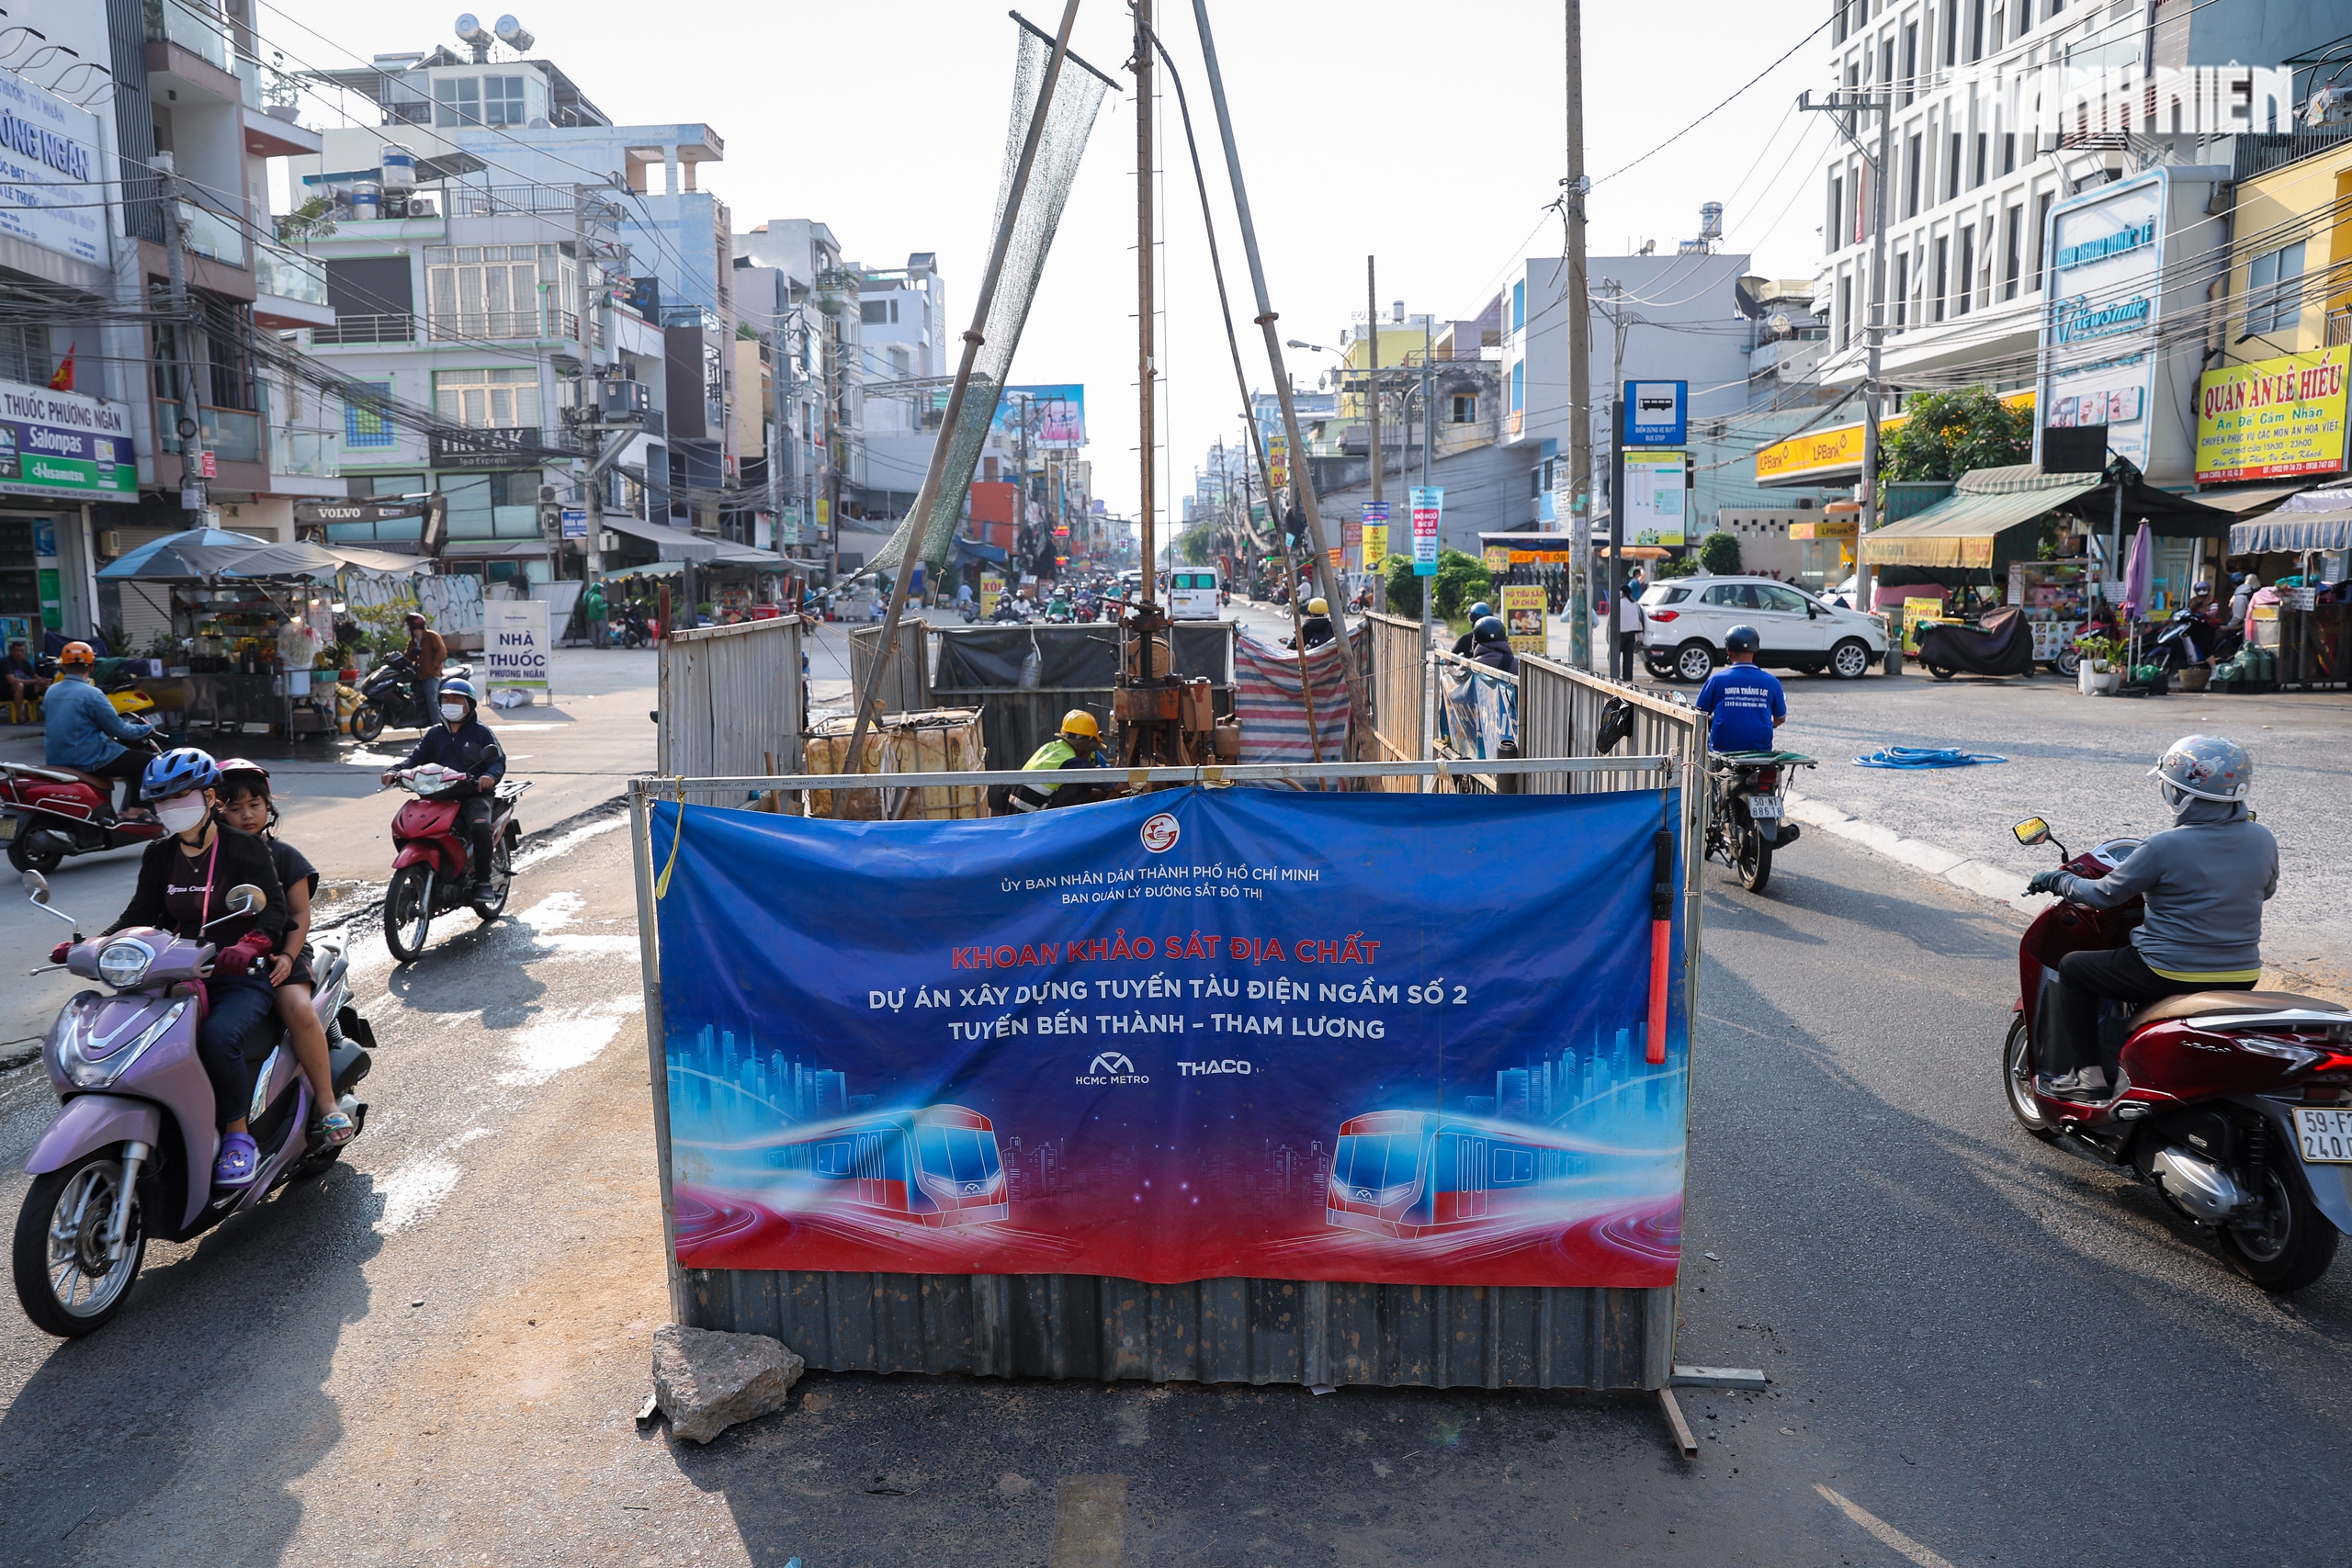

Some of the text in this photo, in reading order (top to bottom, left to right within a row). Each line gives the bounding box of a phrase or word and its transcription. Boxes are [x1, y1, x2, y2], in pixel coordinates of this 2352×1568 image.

[2204, 351, 2343, 421] QUÁN ĂN LÊ HIẾU
[5, 390, 122, 432] THUỐC PHƯƠNG NGÂN
[2260, 412, 2284, 424] Cảm
[2292, 407, 2323, 422] Nhận
[1665, 423, 1676, 434] BUÝT
[2201, 418, 2340, 447] CHUYÊN PHỤC VỤ CÁC MÓN ĂN HOA VIỆT
[29, 426, 83, 455] Salonpas
[2264, 441, 2284, 451] 15h30
[2290, 438, 2312, 448] 23h00
[1813, 443, 1840, 461] LPBank
[2299, 448, 2323, 459] Khách
[477, 457, 507, 466] Express
[1760, 453, 1782, 470] LPBank
[31, 462, 85, 482] Hisamitsu
[318, 508, 361, 519] VOLVO
[1821, 527, 1849, 536] LPBank
[982, 580, 1002, 593] XÔI
[1516, 589, 1530, 598] TIẾU
[1531, 589, 1545, 598] XÀO
[1511, 598, 1521, 606] ÁP
[500, 629, 535, 646] NHÀ
[489, 649, 546, 667] THUỐC
[490, 668, 546, 678] PHƯƠNG NGÂN
[1724, 687, 1740, 695] NHỰA
[1753, 797, 1778, 807] 50-N1
[1752, 807, 1782, 817] 886.18
[1001, 863, 1319, 892] ỦY BAN NHÂN DÂN THÀNH PHỐ HỒ CHÍ MINH
[1061, 882, 1263, 904] BAN QUẢN LÝ ĐƯỜNG SẮT ĐÔ THỊ
[952, 928, 1381, 970] KHOAN KHẢO SÁT ĐỊA CHẤT
[869, 971, 1468, 1013] DỰ ÁN XÂY DỰNG TUYẾN TÀU ĐIỆN NGẦM SỐ 2
[947, 1013, 1029, 1040] TUYẾN
[1036, 1009, 1088, 1034] BẾN
[1095, 1010, 1184, 1034] THÀNH
[1210, 1013, 1283, 1035] THAM
[1292, 1013, 1385, 1040] LƯƠNG
[1177, 1059, 1252, 1076] THACO
[1076, 1075, 1150, 1085] HCMC METRO
